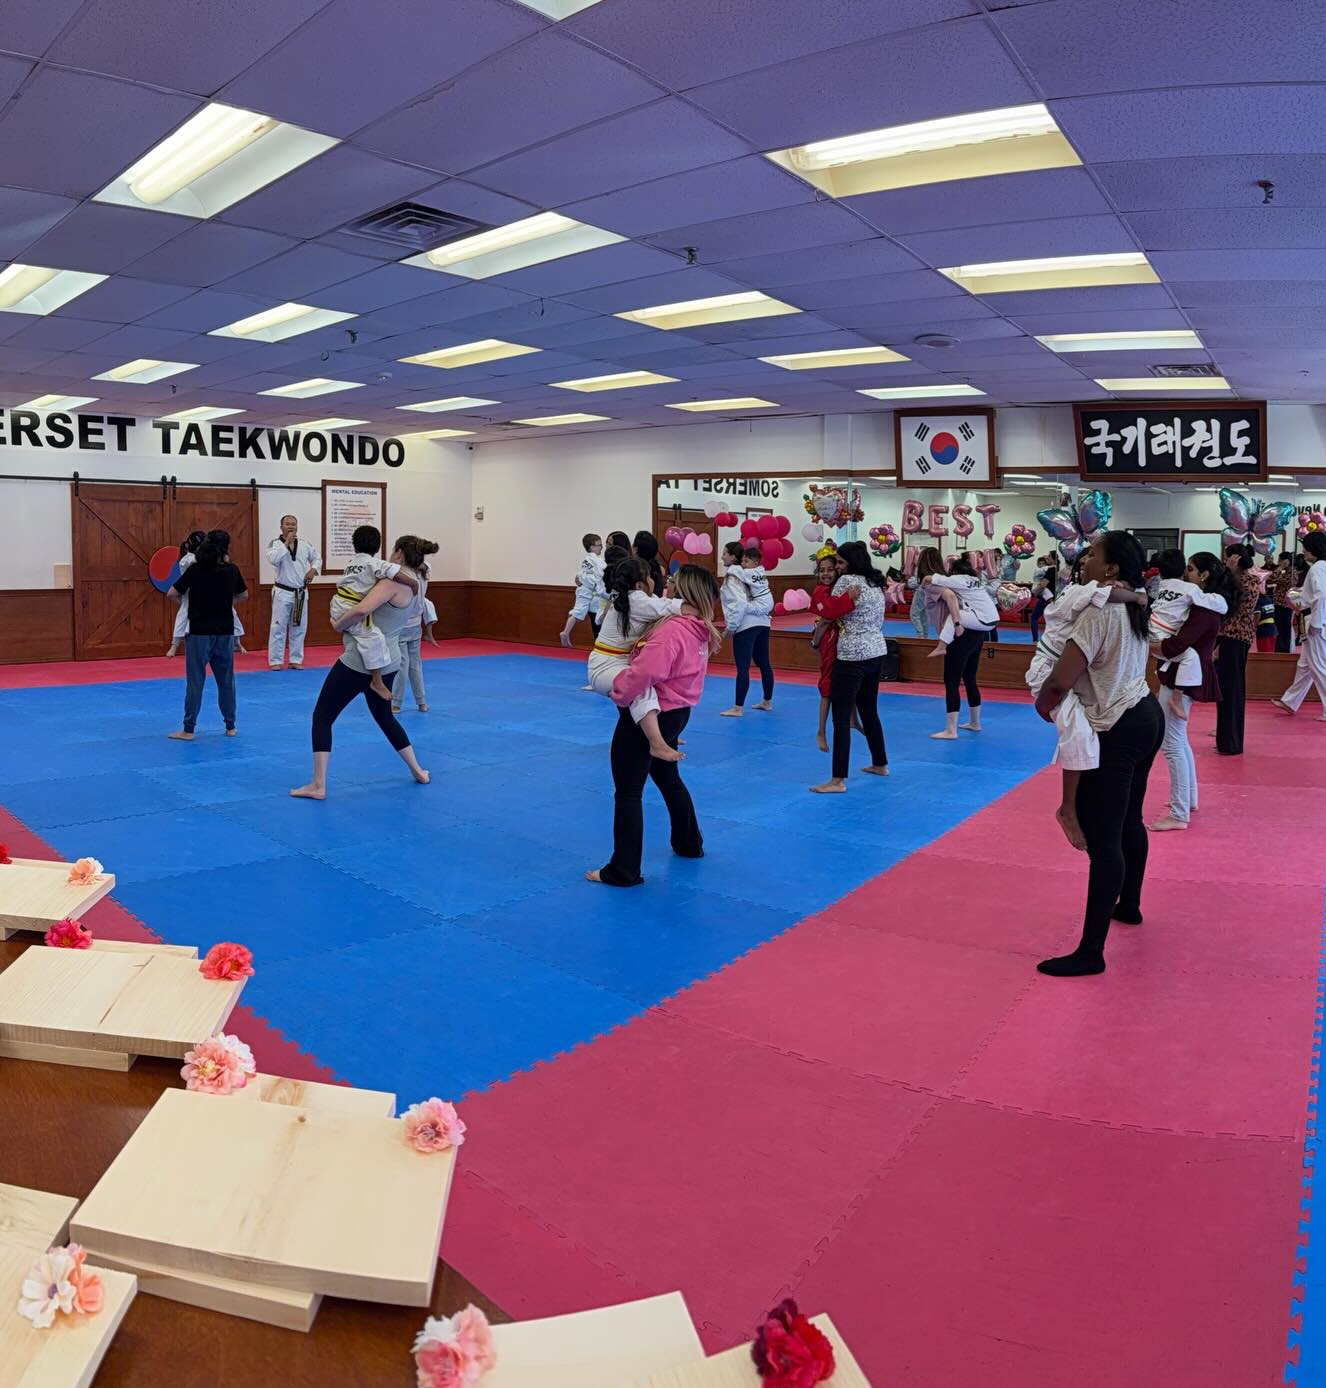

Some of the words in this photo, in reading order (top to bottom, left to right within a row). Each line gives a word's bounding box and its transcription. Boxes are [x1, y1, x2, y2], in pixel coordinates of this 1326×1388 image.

[0, 409, 136, 451] RSET
[152, 419, 405, 468] TAEKWONDO
[1083, 417, 1258, 468] 국기태권도
[902, 499, 1001, 540] BEST
